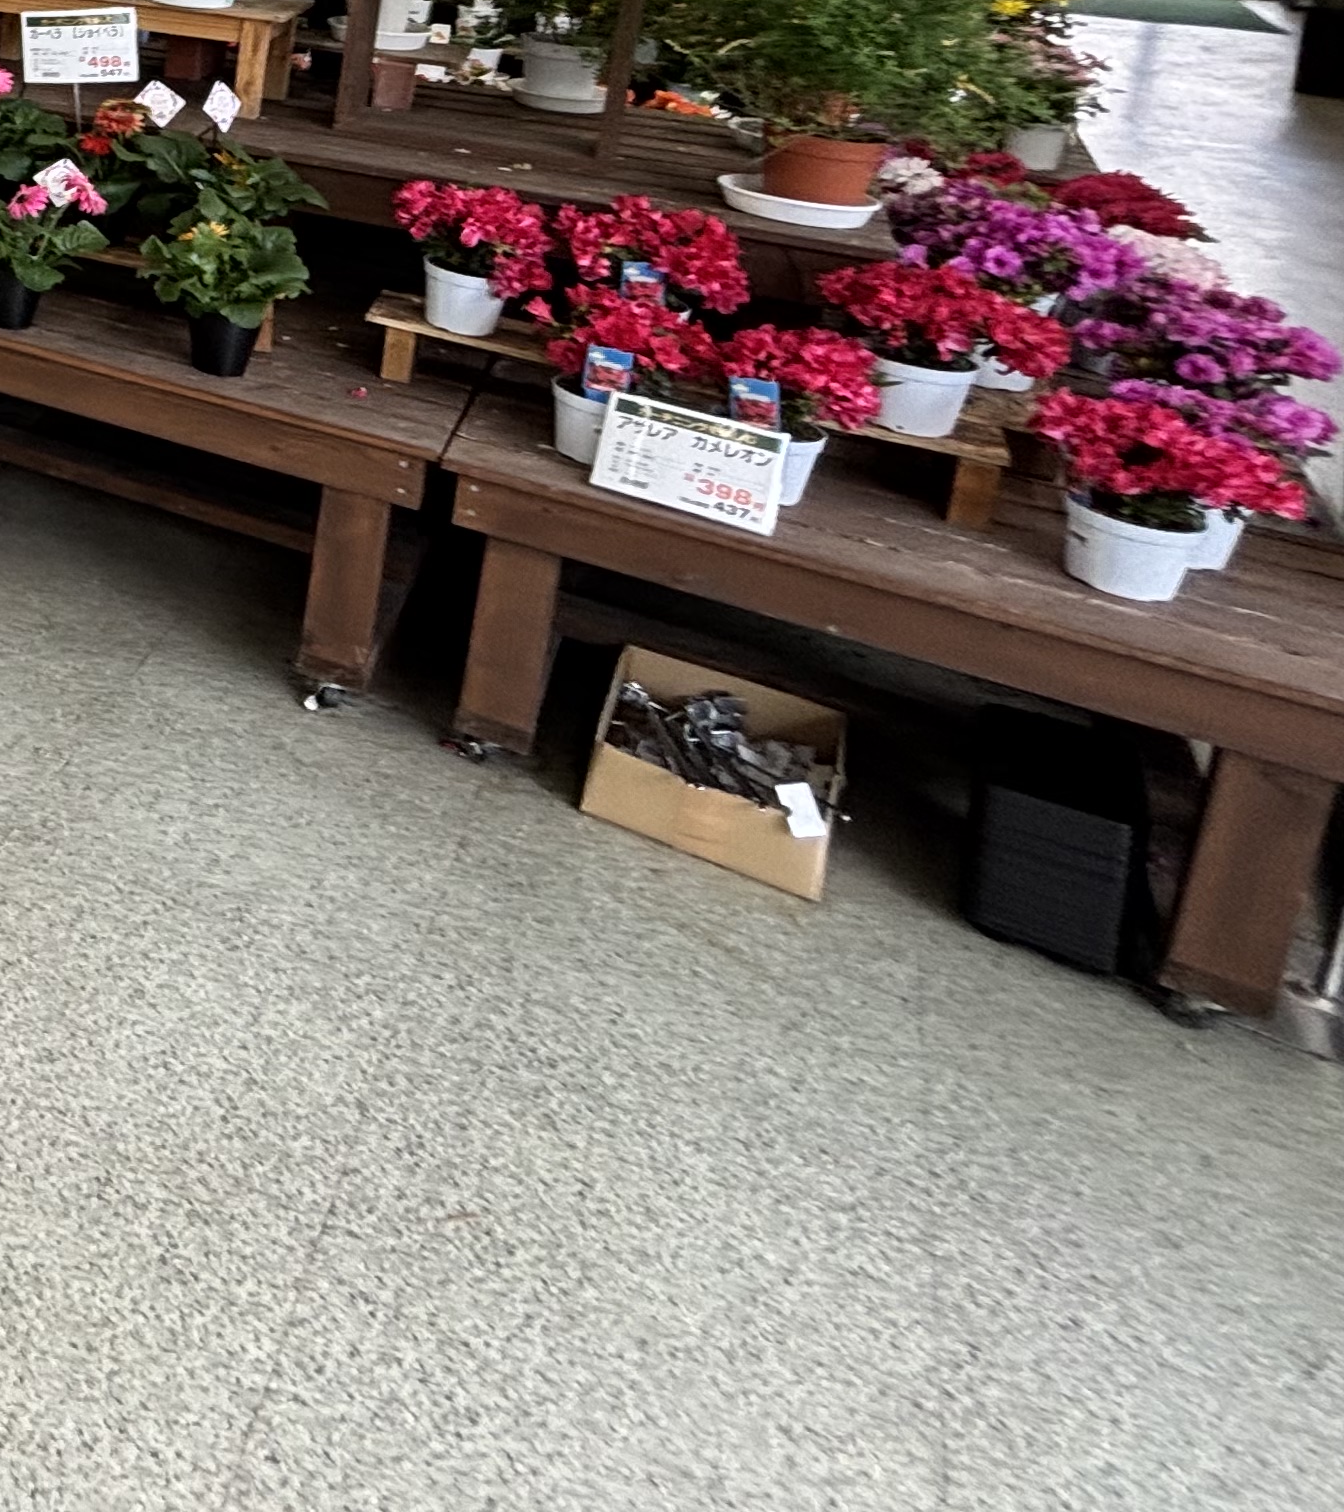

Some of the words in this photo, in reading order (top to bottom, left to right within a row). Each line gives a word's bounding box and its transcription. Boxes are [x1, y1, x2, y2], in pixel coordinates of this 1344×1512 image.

[616, 415, 679, 441] アザレア
[690, 435, 775, 467] カメレオン
